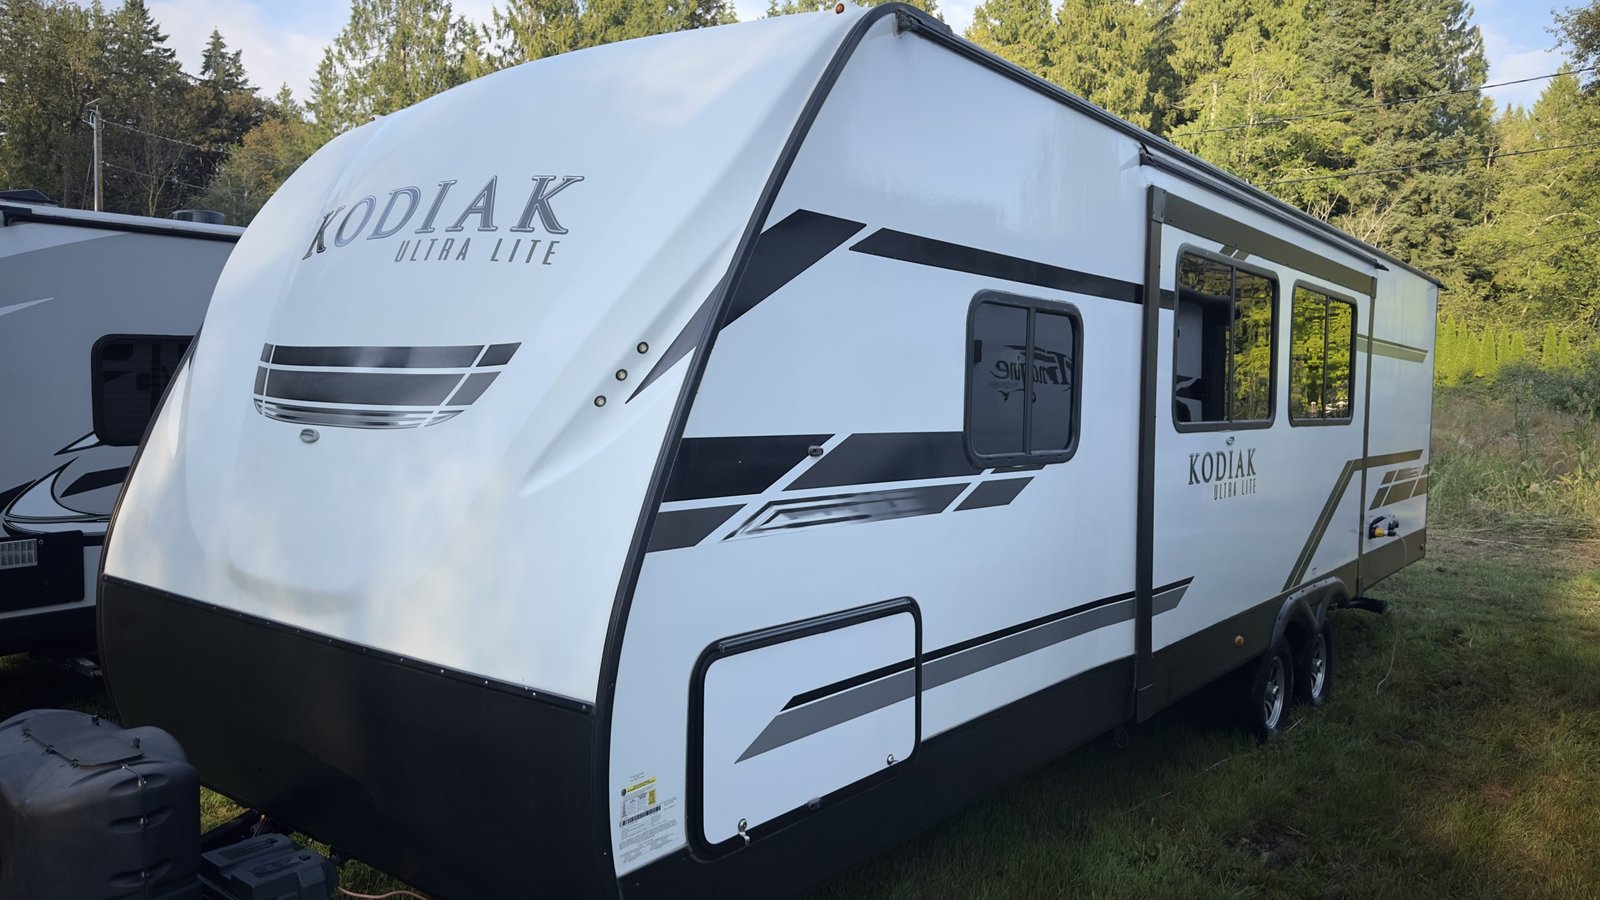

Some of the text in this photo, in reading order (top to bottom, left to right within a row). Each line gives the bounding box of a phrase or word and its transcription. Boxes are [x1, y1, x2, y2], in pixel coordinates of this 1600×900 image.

[302, 175, 585, 261] KODIAK
[394, 238, 560, 266] ULTRA LITE
[1188, 448, 1256, 485] KODIAK
[1213, 478, 1256, 500] ULTRA LITE
